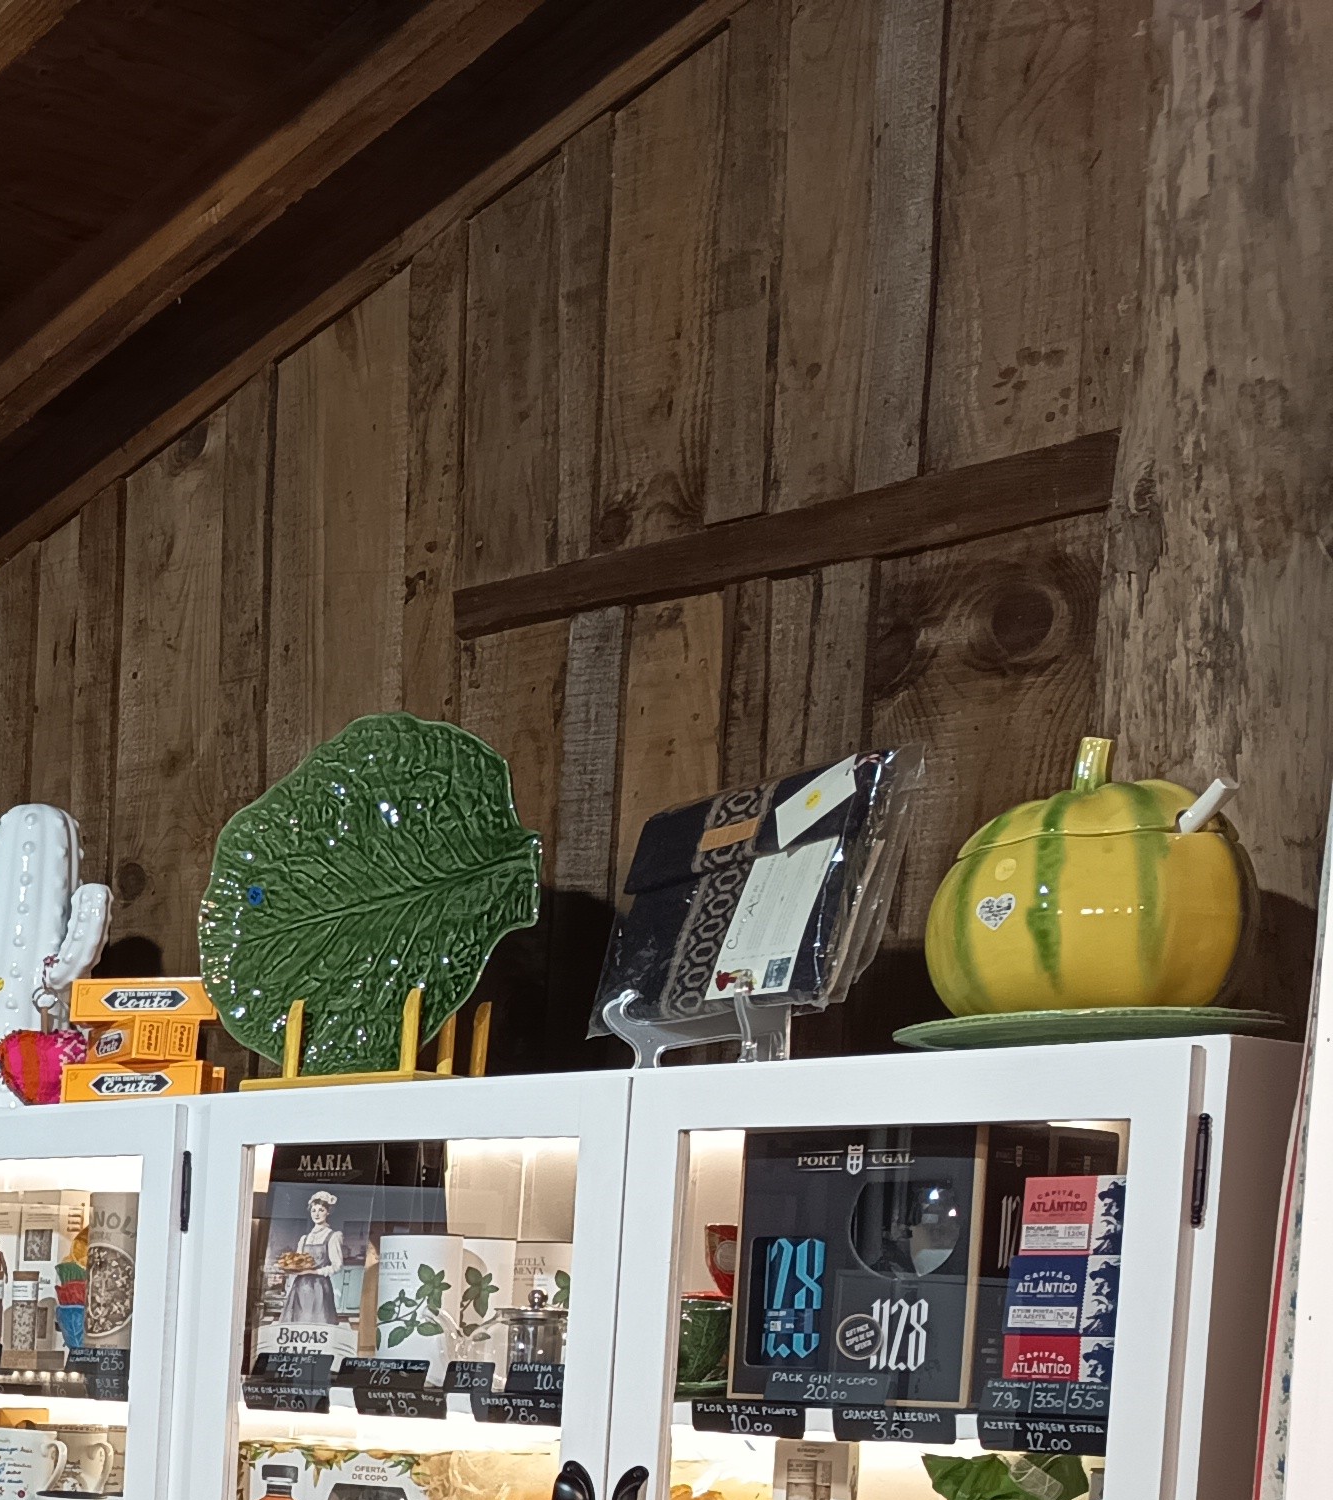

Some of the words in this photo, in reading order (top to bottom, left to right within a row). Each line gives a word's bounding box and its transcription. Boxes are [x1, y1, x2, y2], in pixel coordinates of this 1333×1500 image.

[114, 996, 173, 1008] Couto
[101, 1079, 158, 1093] Couto
[298, 1154, 353, 1171] MARIA
[798, 1155, 840, 1166] PORT
[871, 1153, 915, 1165] UGAL
[1037, 1189, 1081, 1200] CAPITÃO
[1029, 1199, 1088, 1214] ATLÂNTICO
[1024, 1270, 1071, 1281] CAPITÃO
[1016, 1281, 1078, 1294] ATLÂNTICO
[276, 1327, 328, 1346] BROAS
[869, 1299, 929, 1371] 1128
[1018, 1351, 1065, 1362] CAPITÃO
[456, 1363, 482, 1373] BULE
[1011, 1361, 1071, 1375] ATLÂNTICO
[455, 1373, 488, 1388] 18.00
[772, 1371, 803, 1383] PACK
[809, 1374, 832, 1384] GIN
[803, 1385, 847, 1400] 20.00
[992, 1391, 1021, 1410] 7.90
[504, 1407, 539, 1424] 2.80
[697, 1403, 724, 1413] FLOR
[728, 1405, 739, 1414] DE
[742, 1405, 760, 1415] SAL
[842, 1410, 889, 1421] CRACKER
[892, 1411, 941, 1422] ALECRIM
[730, 1414, 773, 1433] 10.00
[983, 1421, 1022, 1430] AZEITE
[1026, 1422, 1066, 1433] VIRGEM
[1069, 1424, 1104, 1433] EXTRA
[872, 1422, 914, 1440] 3.50
[1026, 1431, 1071, 1451] 12.00
[354, 1465, 387, 1474] OFERTA
[364, 1474, 388, 1482] COPO
